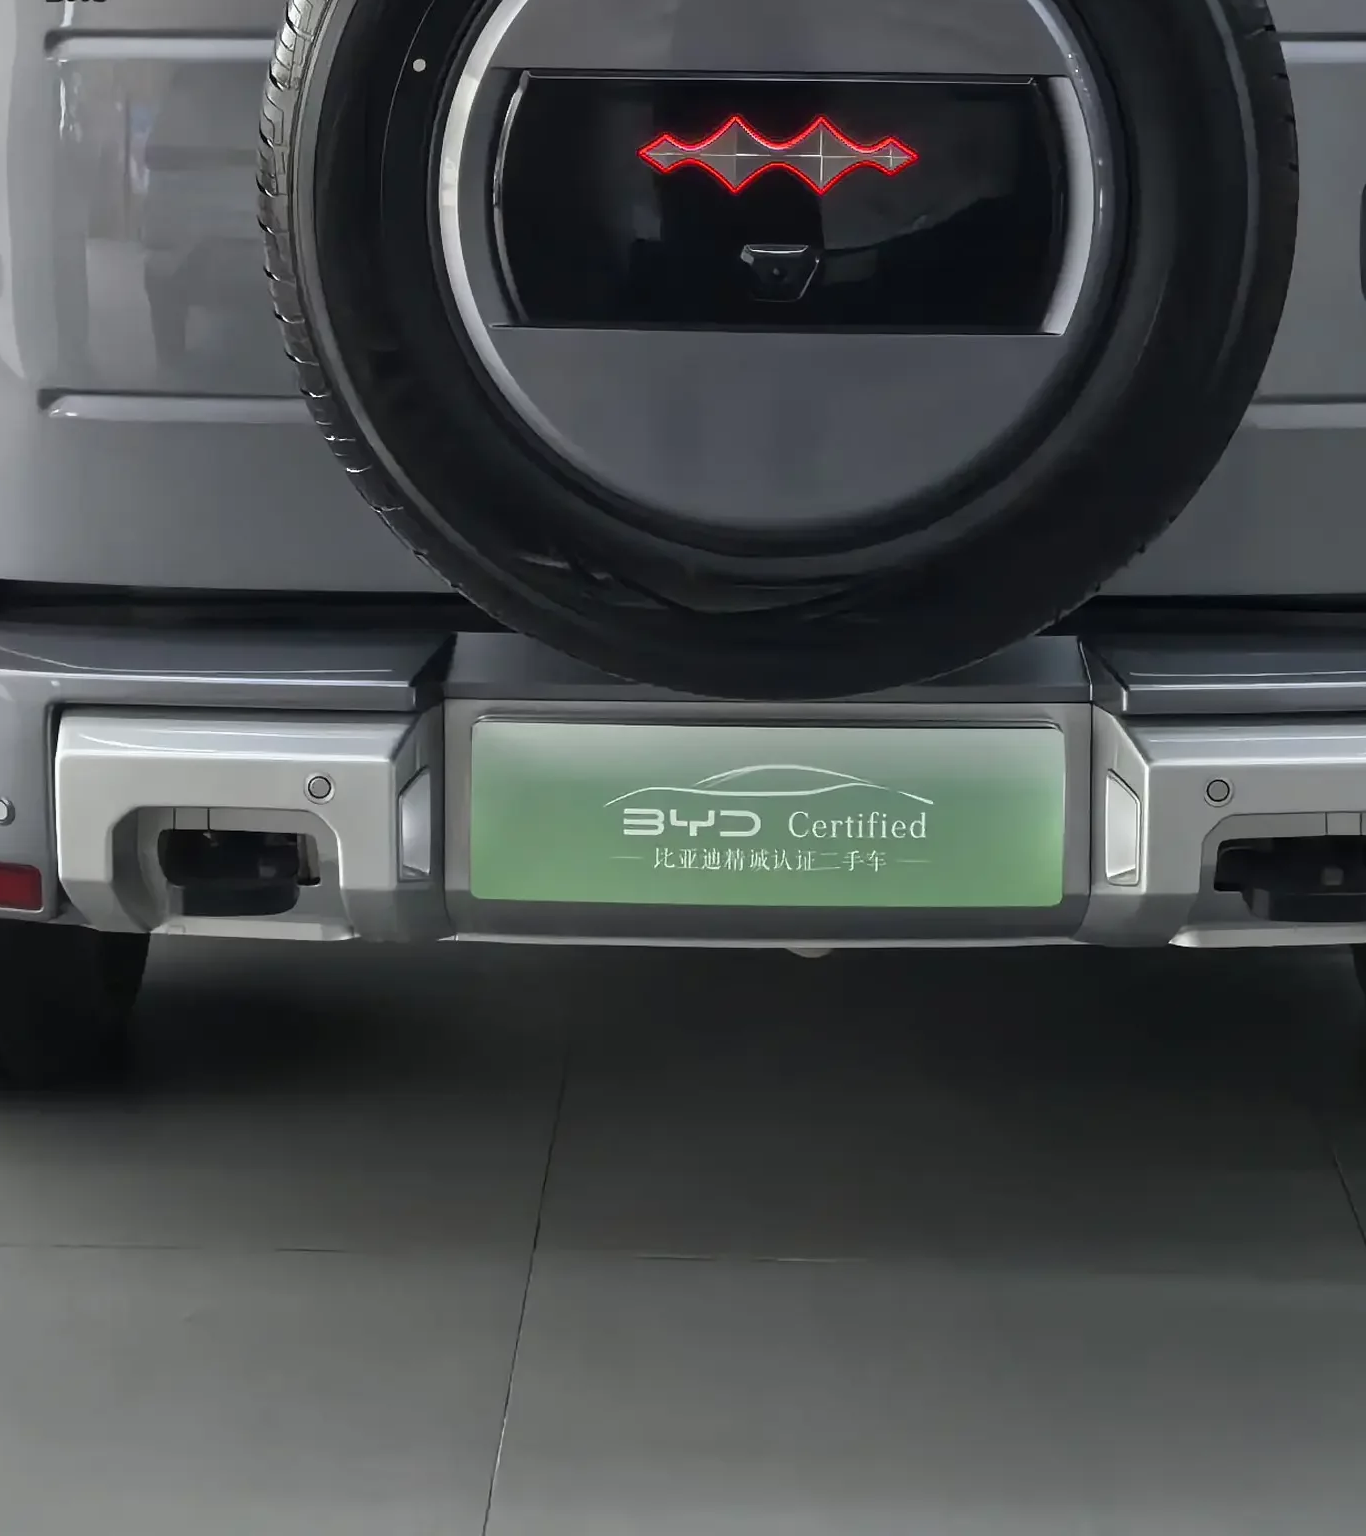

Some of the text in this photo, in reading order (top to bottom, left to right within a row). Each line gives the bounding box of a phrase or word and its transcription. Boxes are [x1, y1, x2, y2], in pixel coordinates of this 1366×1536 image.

[623, 808, 927, 839] BYD Certified
[653, 847, 888, 872] 比亚迪精诚认证二手车
